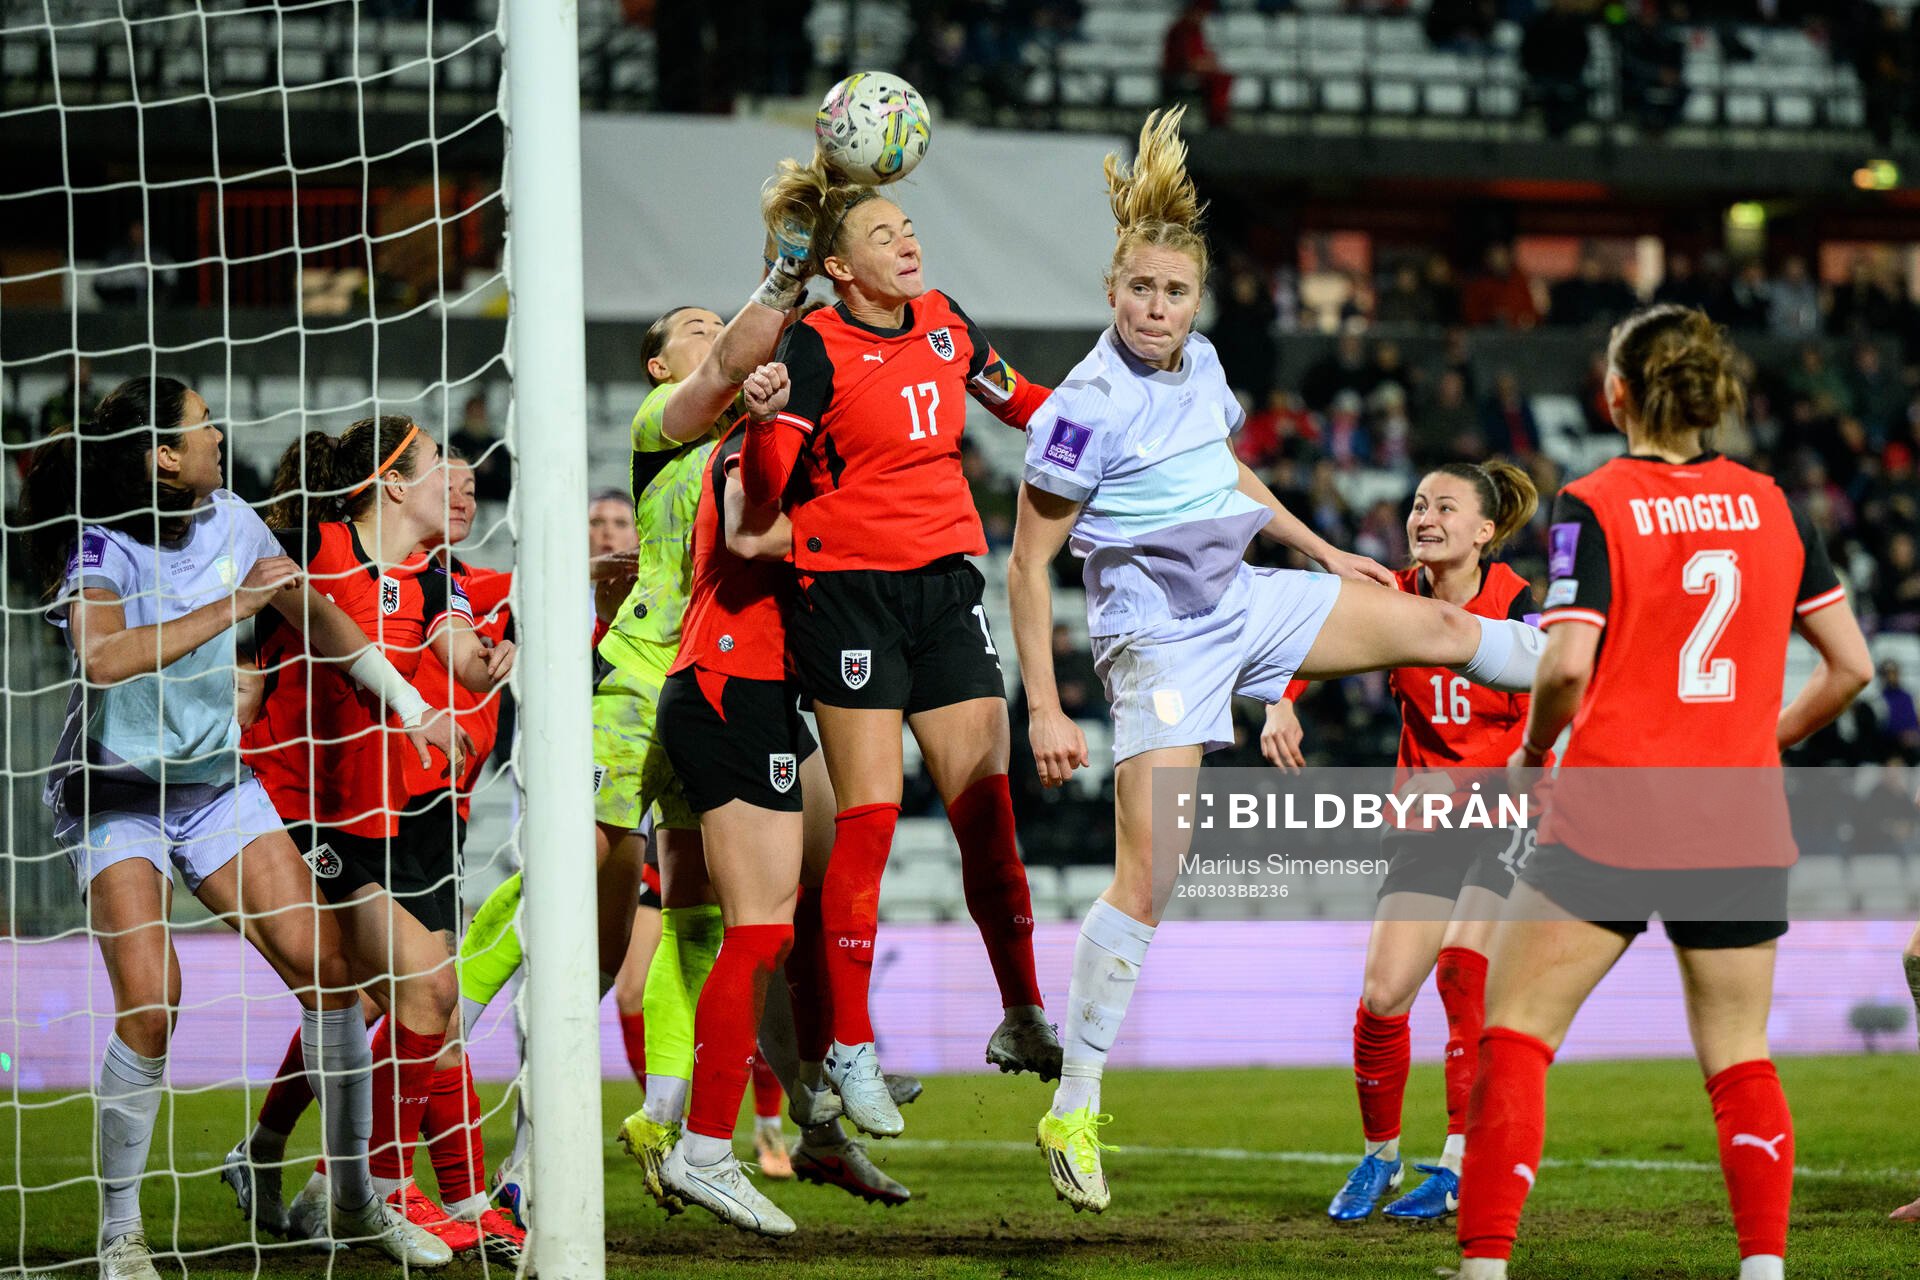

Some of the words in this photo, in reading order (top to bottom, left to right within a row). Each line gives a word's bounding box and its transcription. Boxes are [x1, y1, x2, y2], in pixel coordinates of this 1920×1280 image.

[900, 381, 940, 441] 17
[1629, 494, 1761, 536] D'ANGELO
[1677, 549, 1741, 704] 2
[1429, 674, 1471, 725] 16
[838, 936, 871, 948] ÖFB
